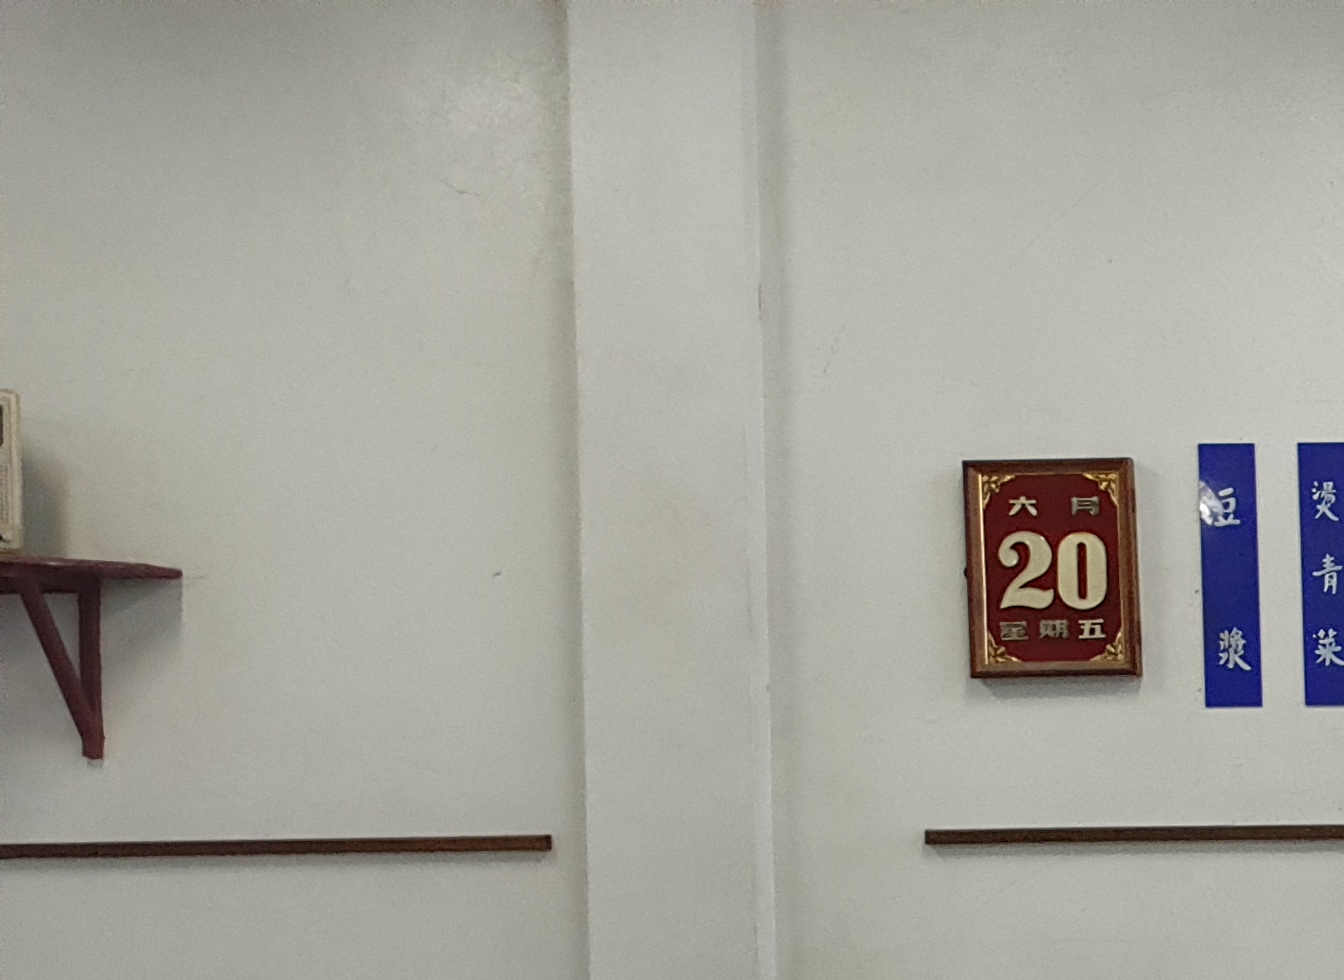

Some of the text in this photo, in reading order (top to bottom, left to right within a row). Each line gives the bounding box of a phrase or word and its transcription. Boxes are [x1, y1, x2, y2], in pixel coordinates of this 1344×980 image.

[1008, 496, 1100, 516] 六月
[998, 531, 1107, 610] 20
[1210, 486, 1252, 672] 豆漿
[999, 618, 1106, 640] 星期五
